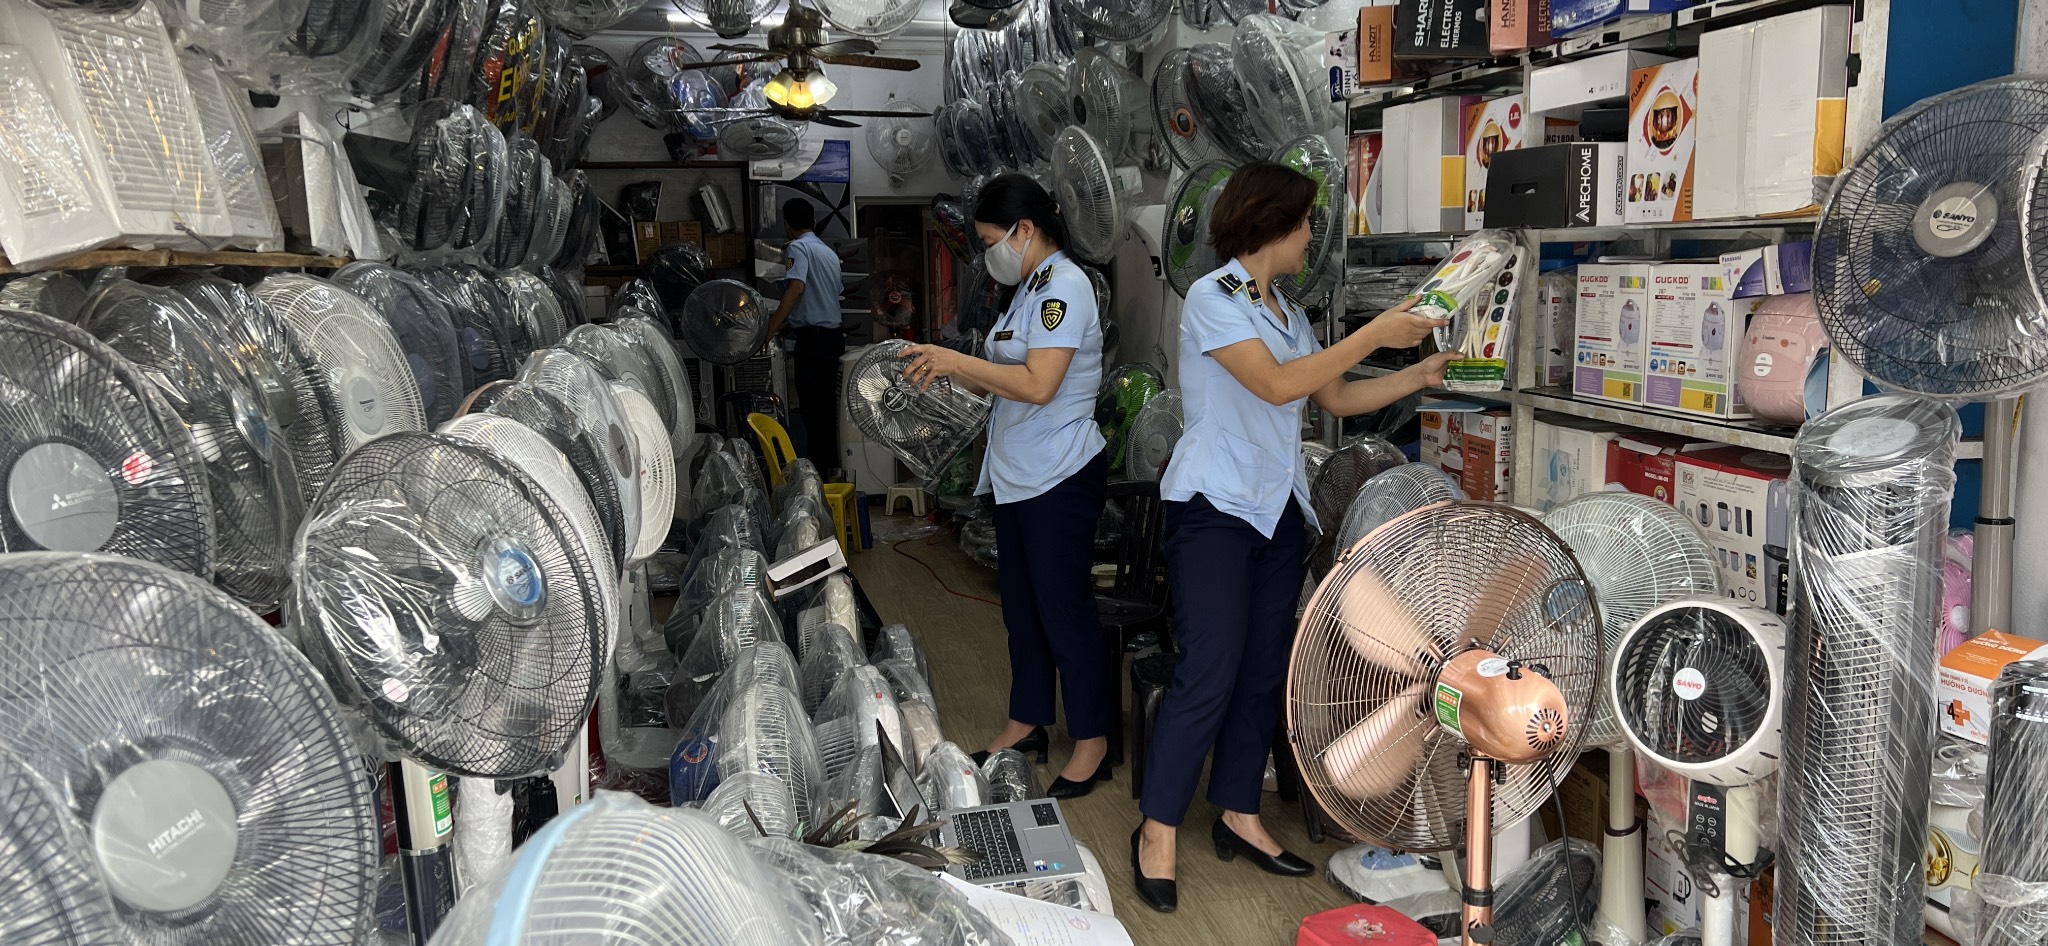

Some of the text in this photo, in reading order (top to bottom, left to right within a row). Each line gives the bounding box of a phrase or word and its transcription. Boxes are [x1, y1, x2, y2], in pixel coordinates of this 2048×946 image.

[1369, 25, 1377, 62] HANZIT
[1414, 0, 1428, 47] SHAR
[1440, 0, 1454, 48] ELECTRIC
[1452, 11, 1462, 49] THERMOS
[1576, 148, 1592, 223] APECHOME
[1943, 212, 1974, 222] SANYO
[1677, 679, 1702, 690] SANYO
[148, 809, 203, 854] HITACHI
